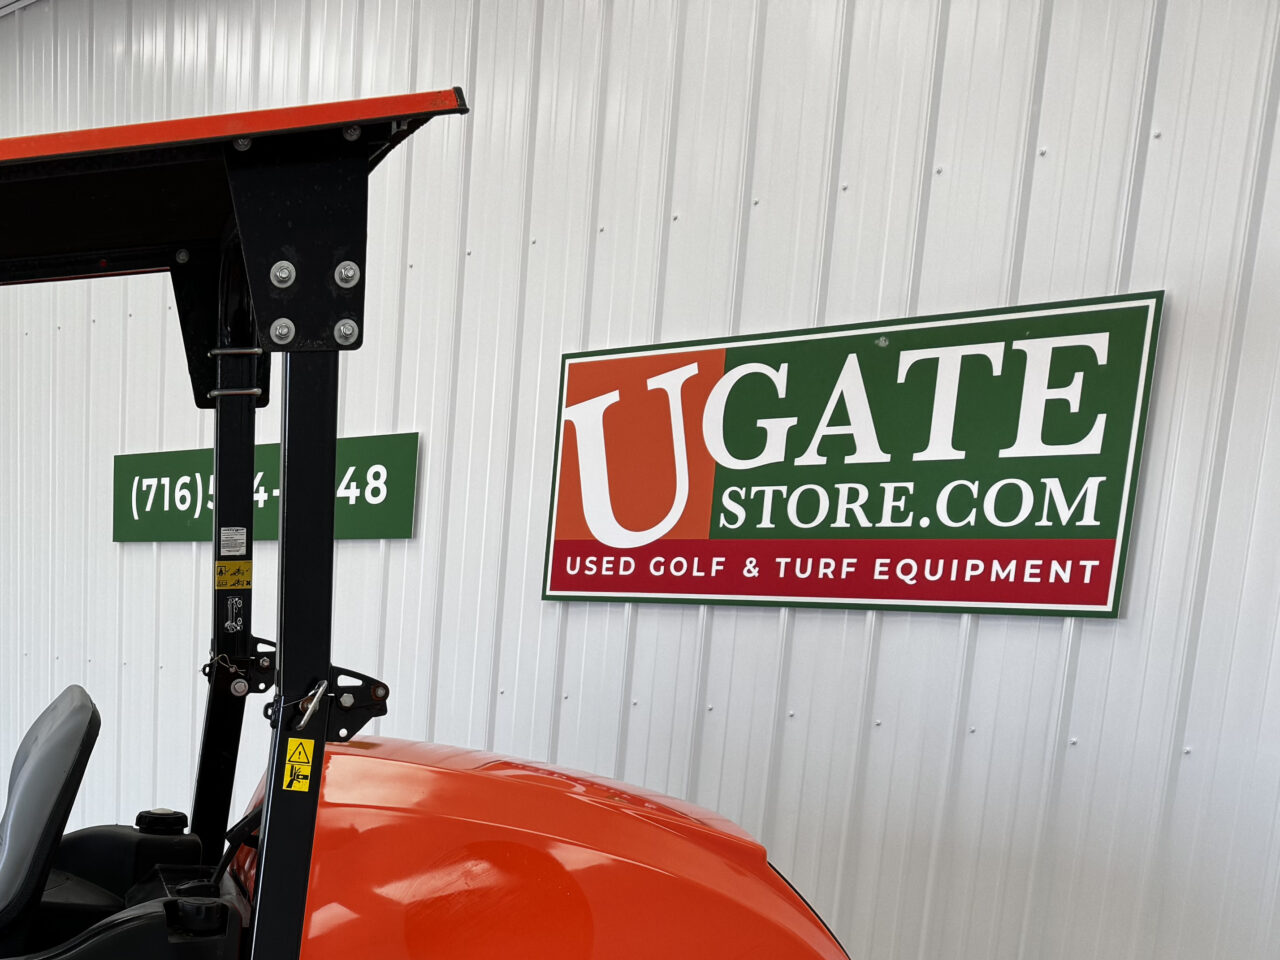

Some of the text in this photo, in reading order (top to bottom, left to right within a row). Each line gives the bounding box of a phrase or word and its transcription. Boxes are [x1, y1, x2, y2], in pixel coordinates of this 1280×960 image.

[719, 476, 1107, 529] STORE.COM
[566, 556, 1100, 585] USED GOLF & TURF EQUIPMENT
